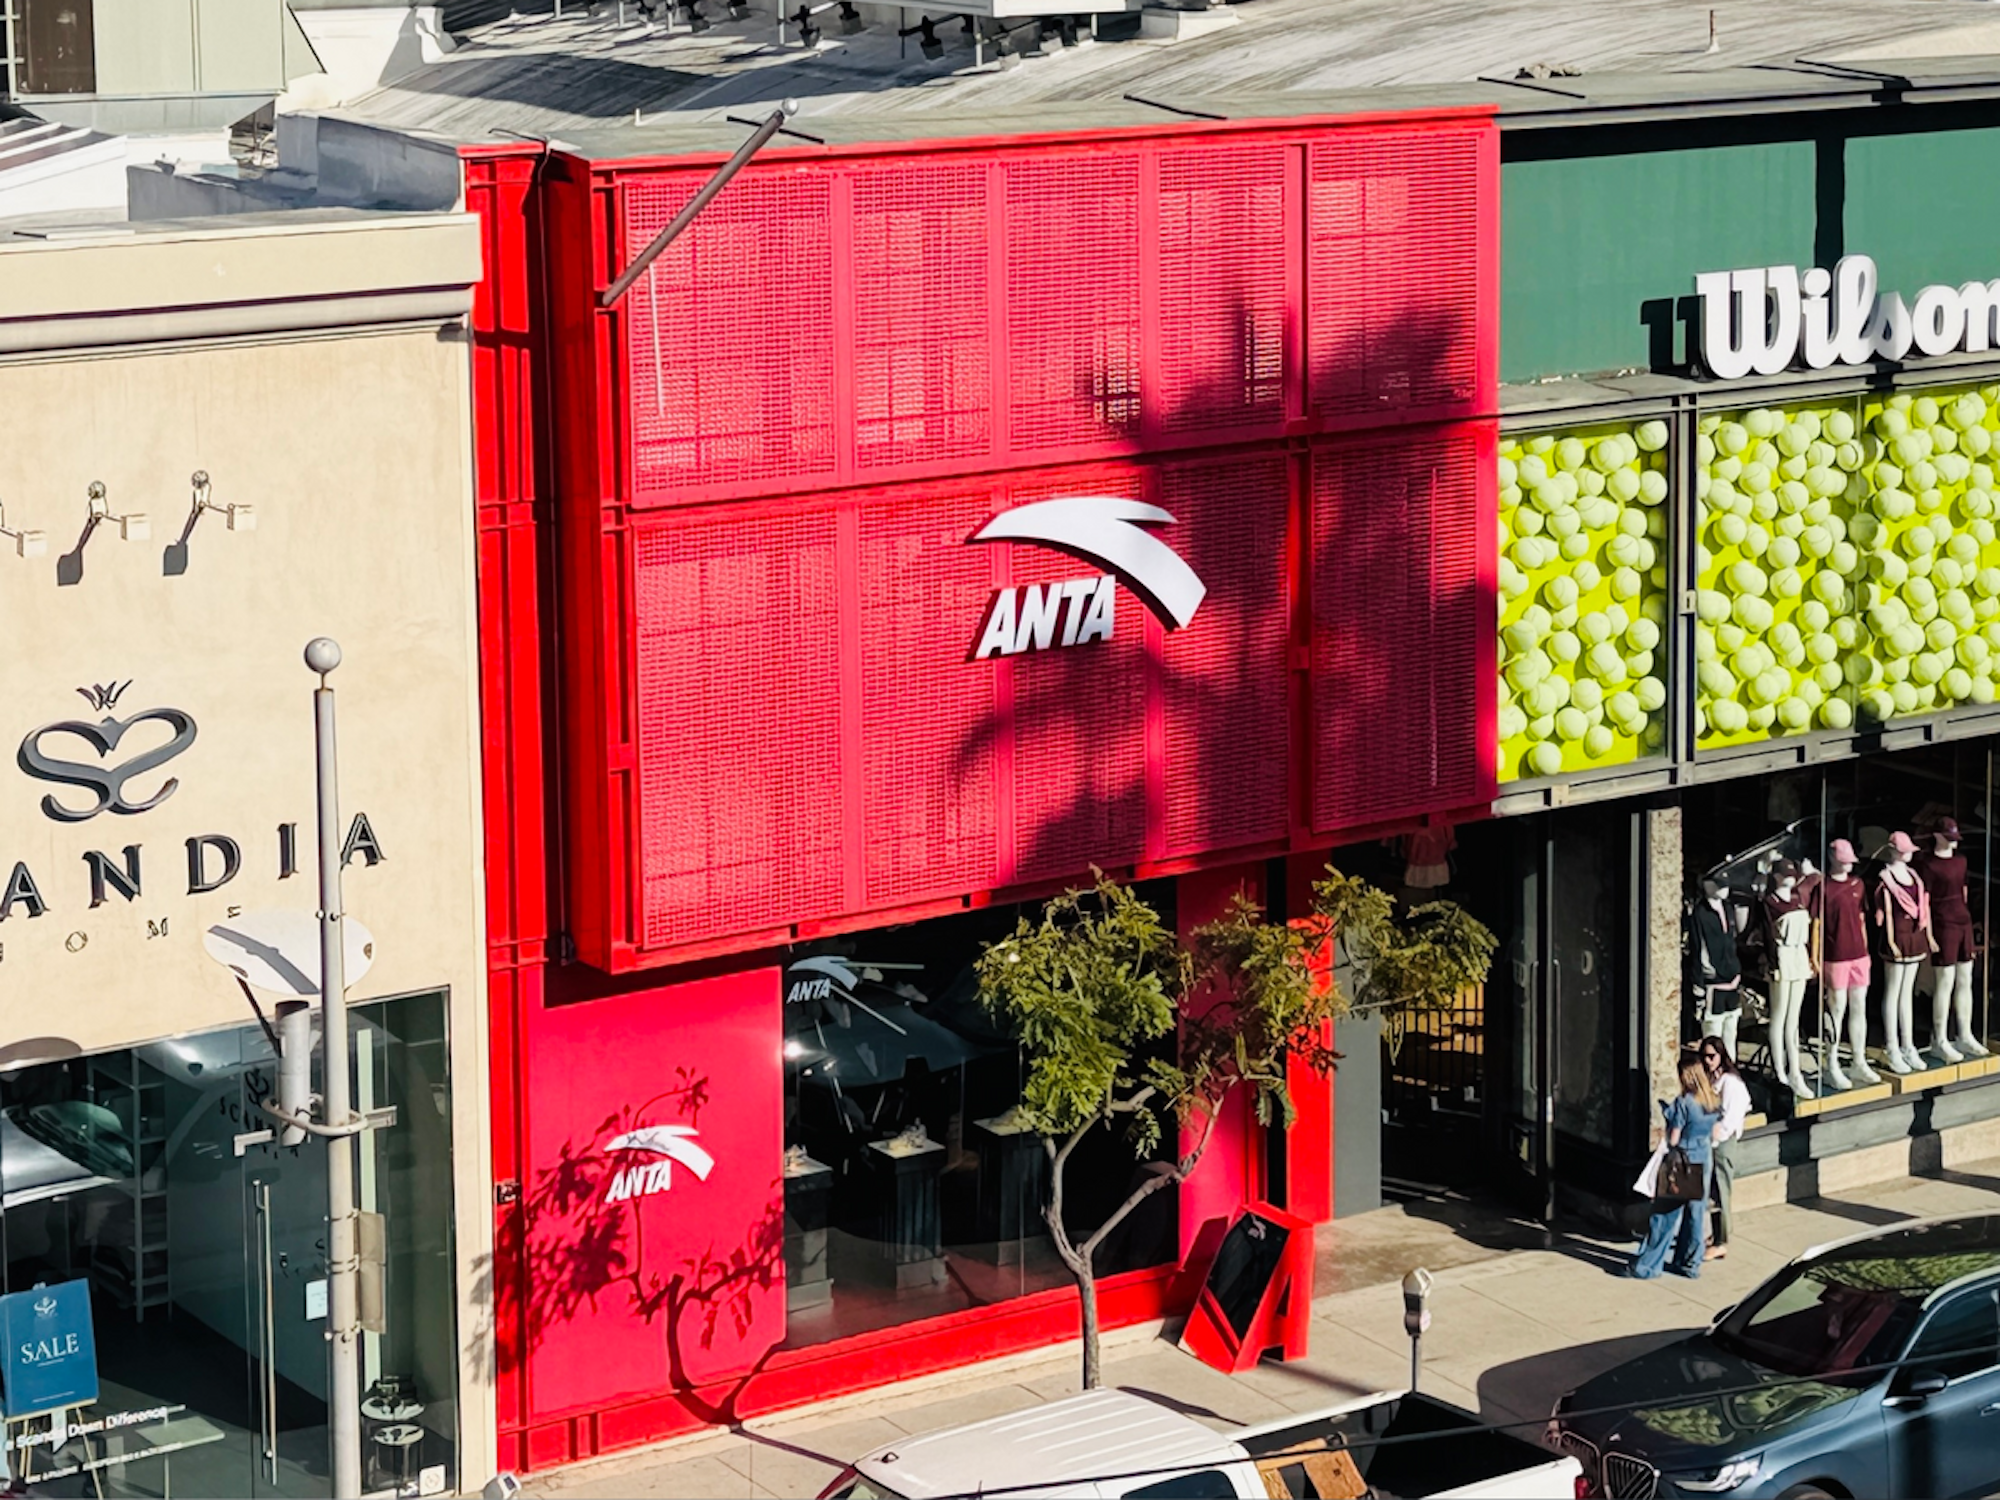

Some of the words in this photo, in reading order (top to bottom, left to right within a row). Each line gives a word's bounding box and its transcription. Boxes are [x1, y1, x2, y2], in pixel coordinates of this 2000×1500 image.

[1694, 254, 2000, 380] Wilson
[974, 574, 1116, 660] ANTA
[786, 977, 831, 1005] ANTA
[604, 1159, 672, 1204] ANTA
[20, 1332, 80, 1365] SALE
